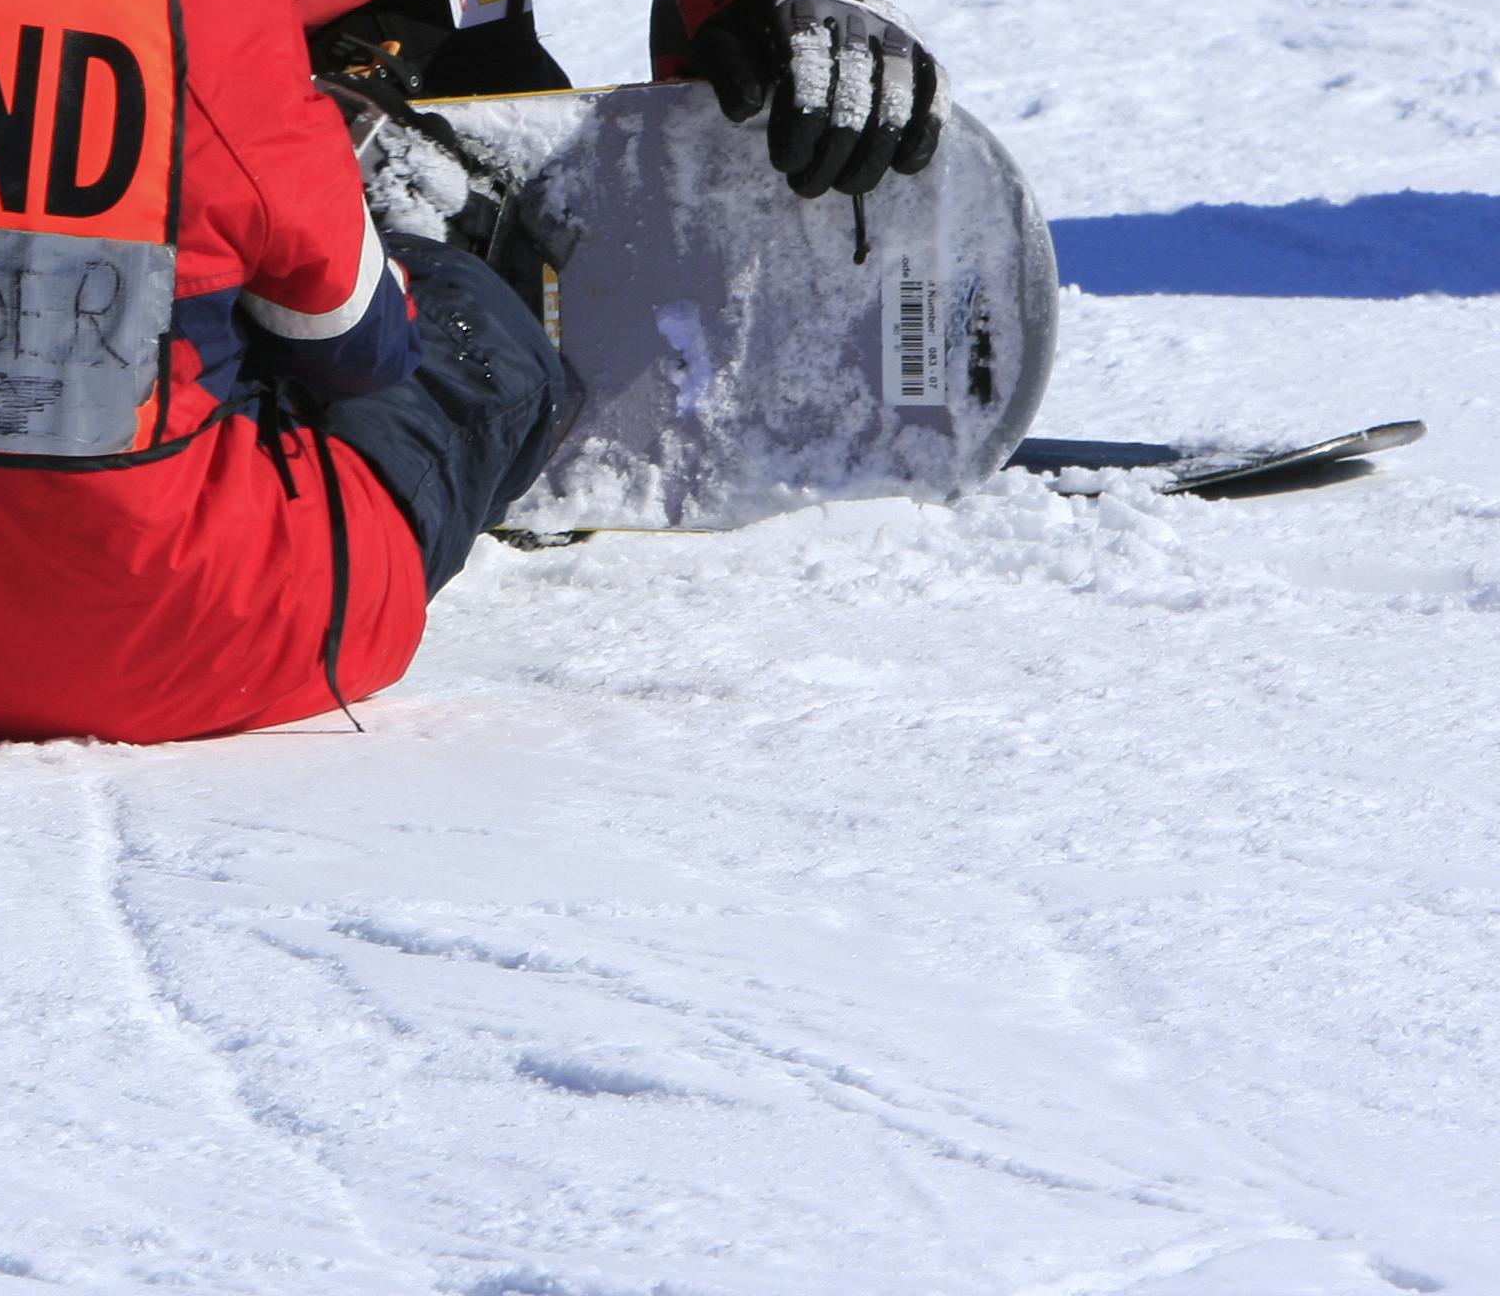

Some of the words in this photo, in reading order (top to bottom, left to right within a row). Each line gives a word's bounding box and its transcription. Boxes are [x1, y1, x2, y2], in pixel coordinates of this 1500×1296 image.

[902, 255, 911, 278] ode
[928, 289, 937, 337] Number:
[928, 347, 937, 366] 083
[928, 377, 938, 389] 07
